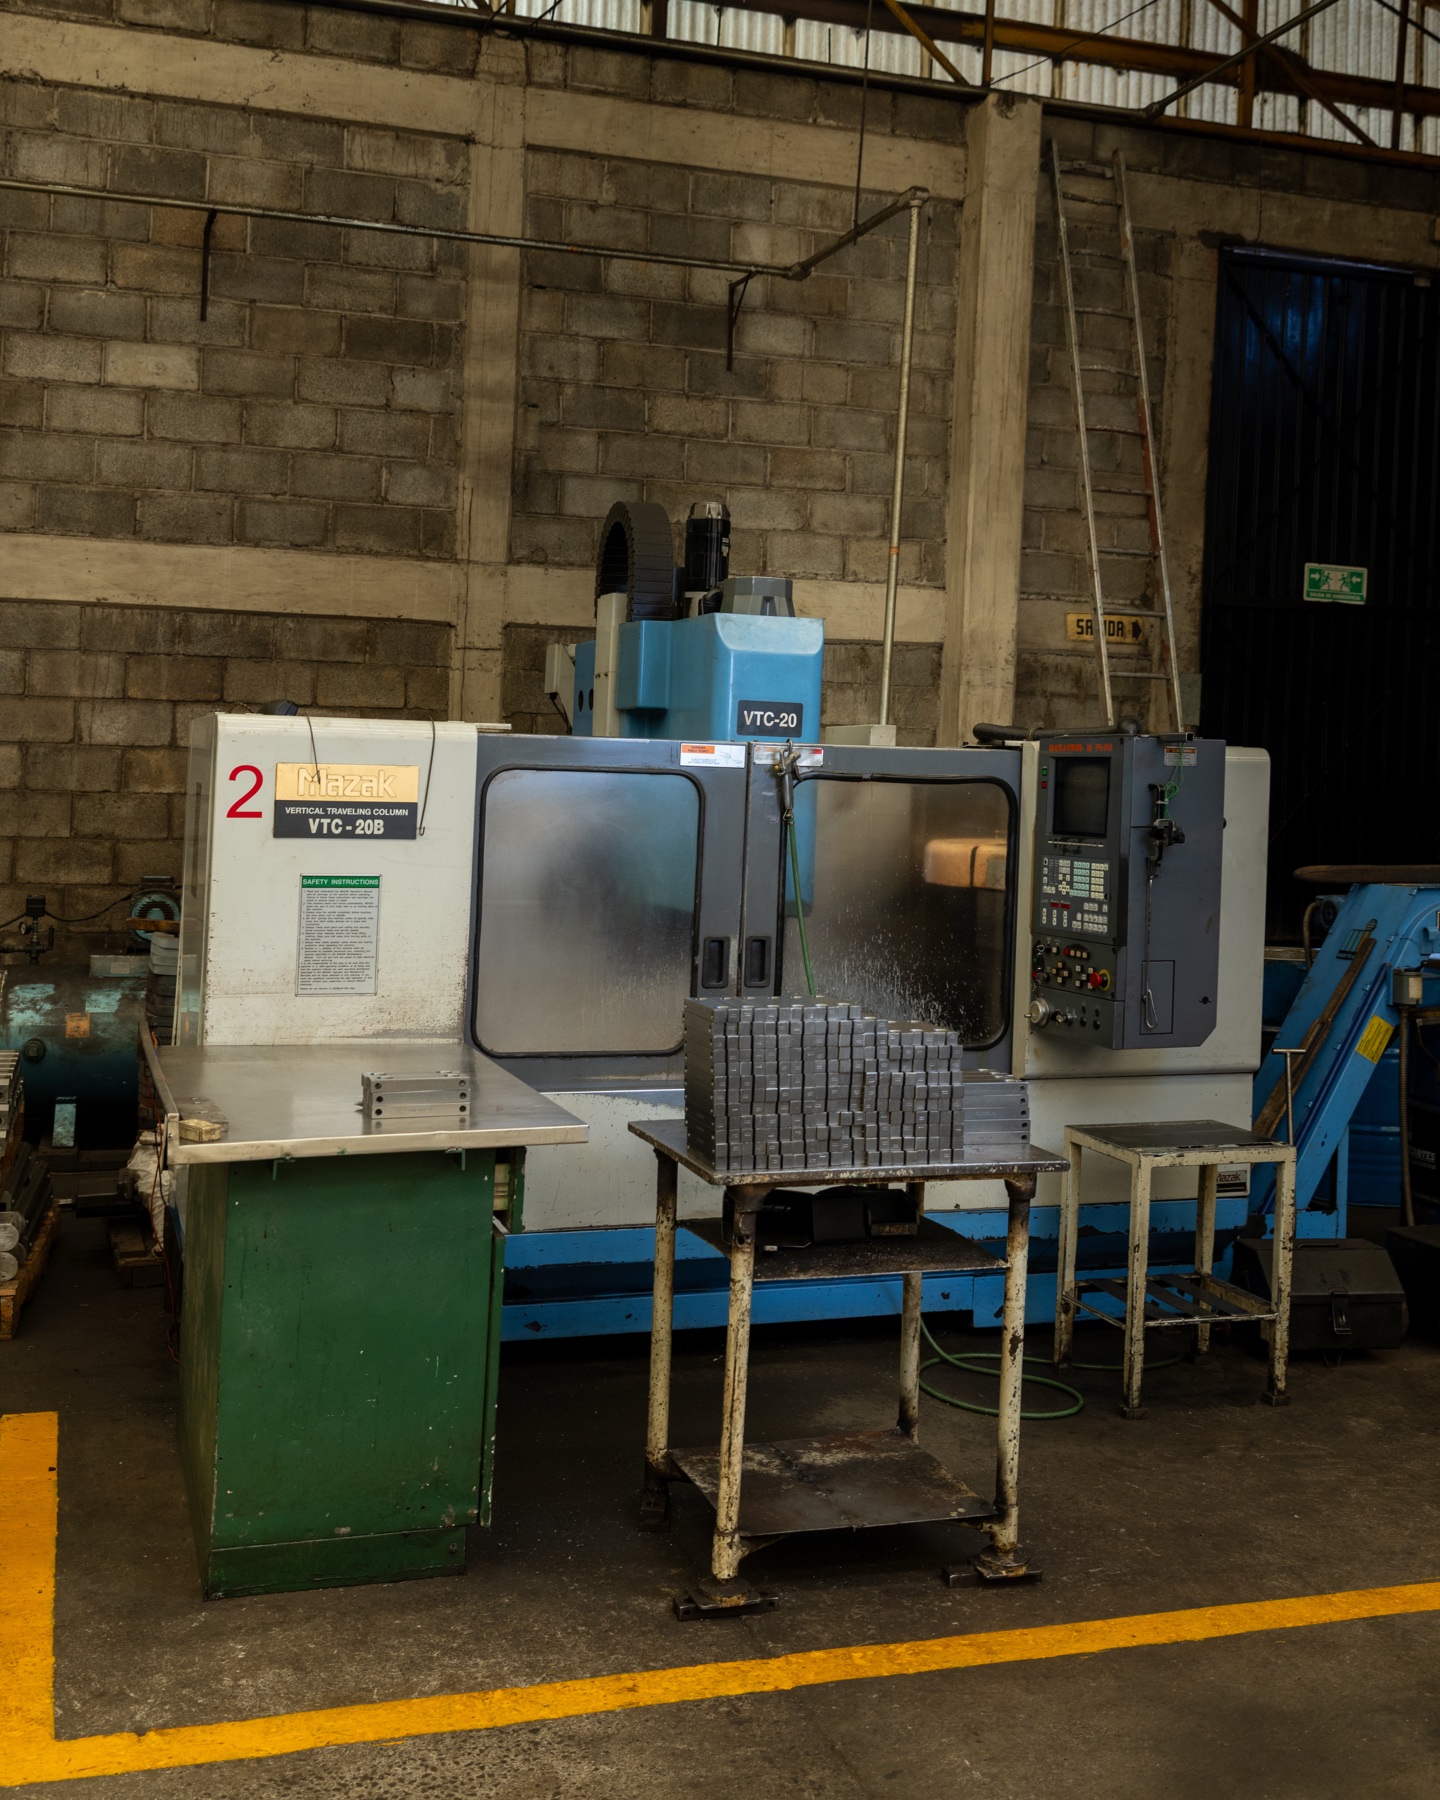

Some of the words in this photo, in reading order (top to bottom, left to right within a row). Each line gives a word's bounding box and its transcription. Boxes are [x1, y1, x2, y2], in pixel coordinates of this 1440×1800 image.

[1076, 618, 1124, 637] SAIDA
[743, 710, 798, 728] VTC-20
[226, 765, 264, 819] 2
[297, 767, 397, 798] Mazak
[285, 806, 325, 815] VERTICAL
[326, 807, 371, 816] TRAVELING
[372, 808, 409, 817] COLUMN
